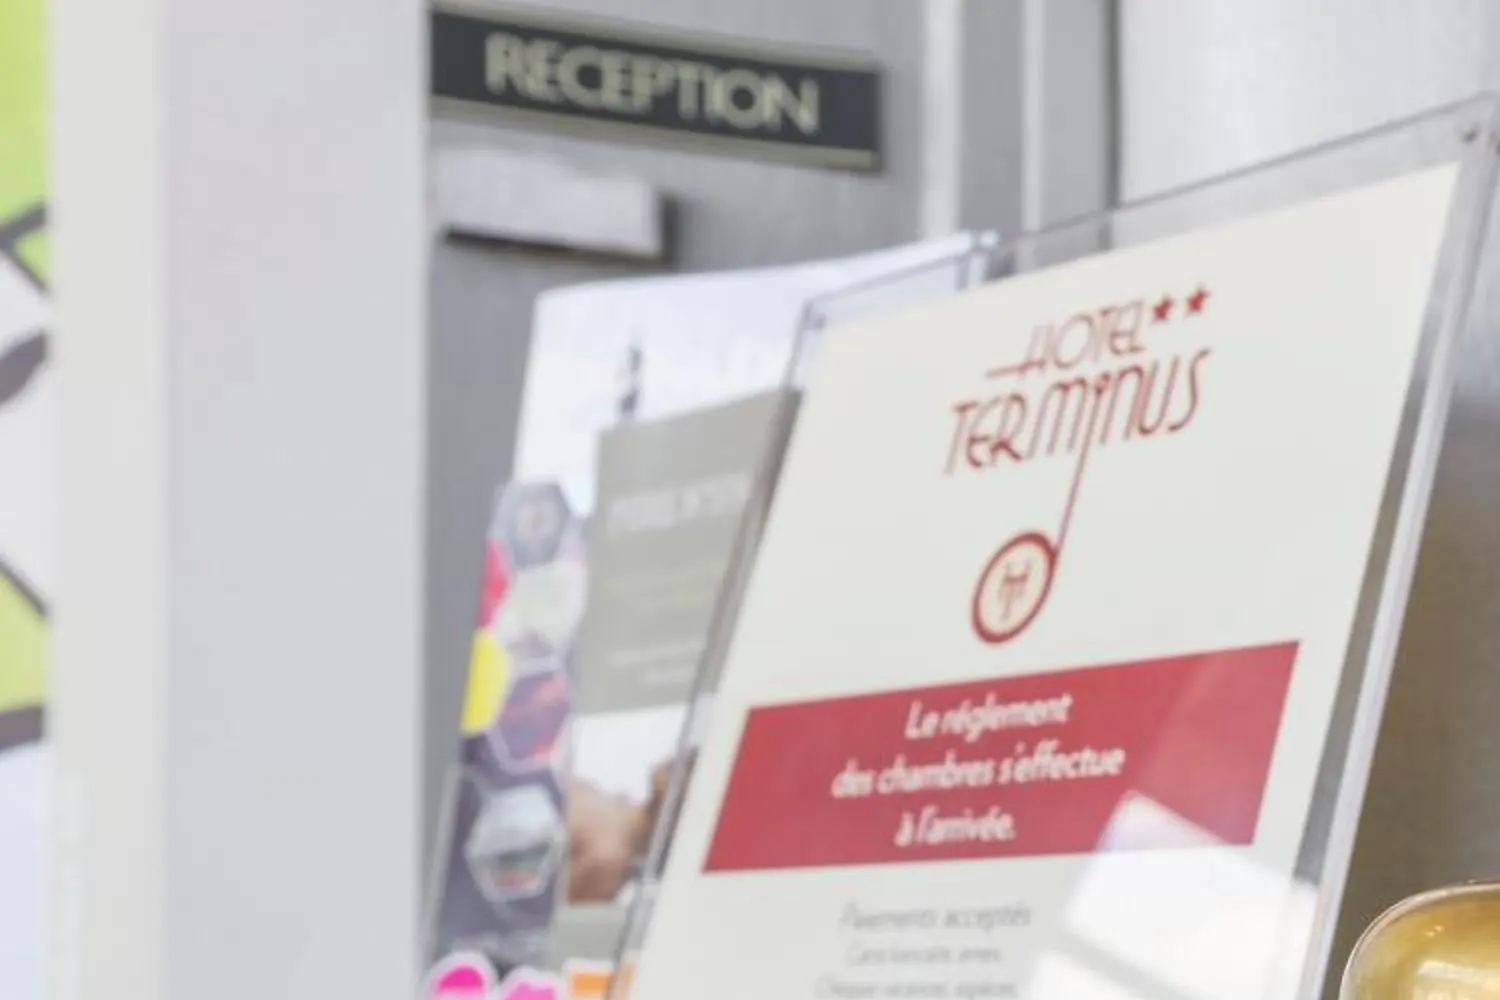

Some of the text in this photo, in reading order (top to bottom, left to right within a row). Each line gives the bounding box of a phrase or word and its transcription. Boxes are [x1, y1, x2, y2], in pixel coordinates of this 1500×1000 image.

[486, 32, 821, 134] RECEPTION
[986, 299, 1147, 379] HOTEL
[944, 347, 1212, 476] TERMINUS
[905, 699, 938, 739] Le
[832, 757, 874, 797] des
[877, 749, 995, 794] chambres
